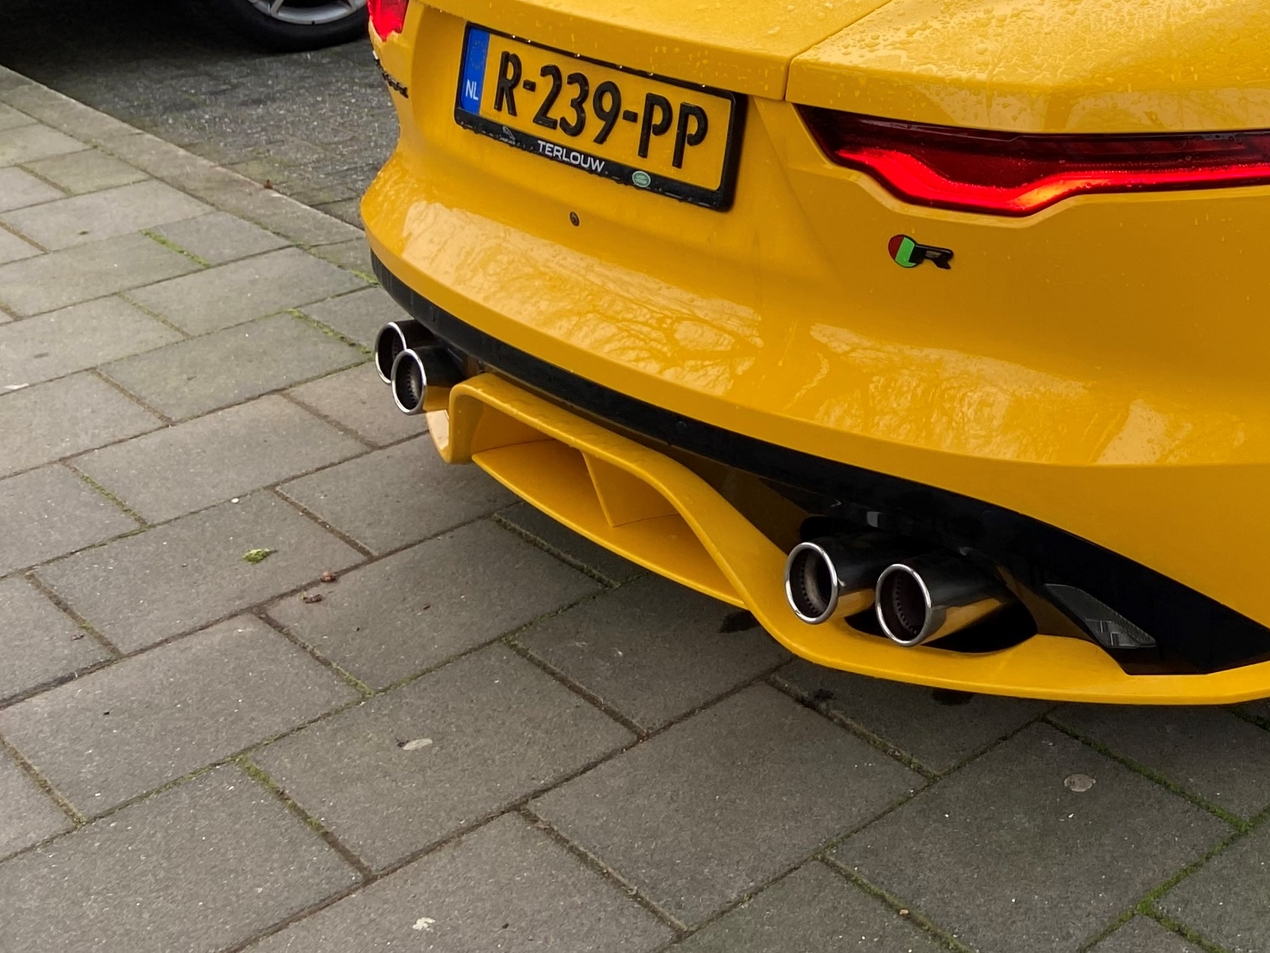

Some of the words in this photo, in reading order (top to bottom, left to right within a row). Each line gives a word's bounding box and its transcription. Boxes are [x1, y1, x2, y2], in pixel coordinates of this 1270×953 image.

[465, 79, 479, 101] NL
[494, 50, 709, 169] R-239-PP
[537, 140, 606, 173] TERLOUW
